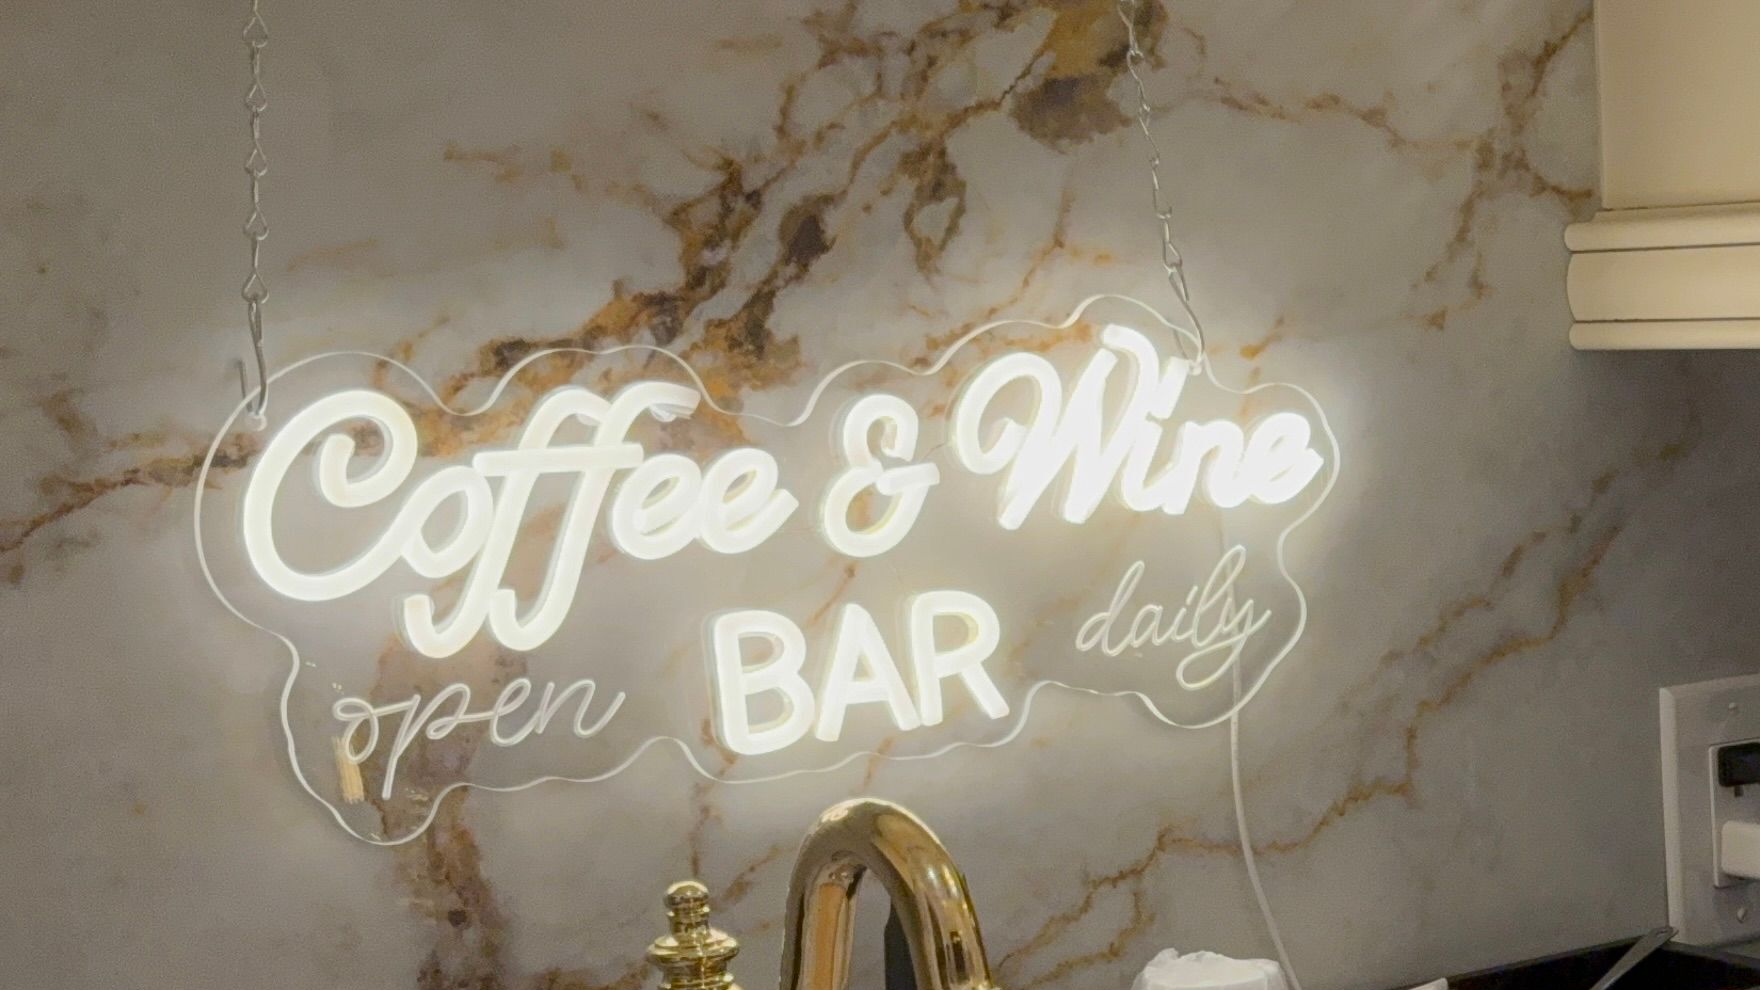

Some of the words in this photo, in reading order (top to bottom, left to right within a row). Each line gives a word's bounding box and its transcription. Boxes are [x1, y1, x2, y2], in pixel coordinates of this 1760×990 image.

[240, 378, 799, 661] Coffee
[819, 393, 940, 558] &
[954, 323, 1325, 531] Wine
[710, 590, 1010, 756] BAR
[1074, 545, 1273, 692] daily
[331, 676, 626, 800] open
